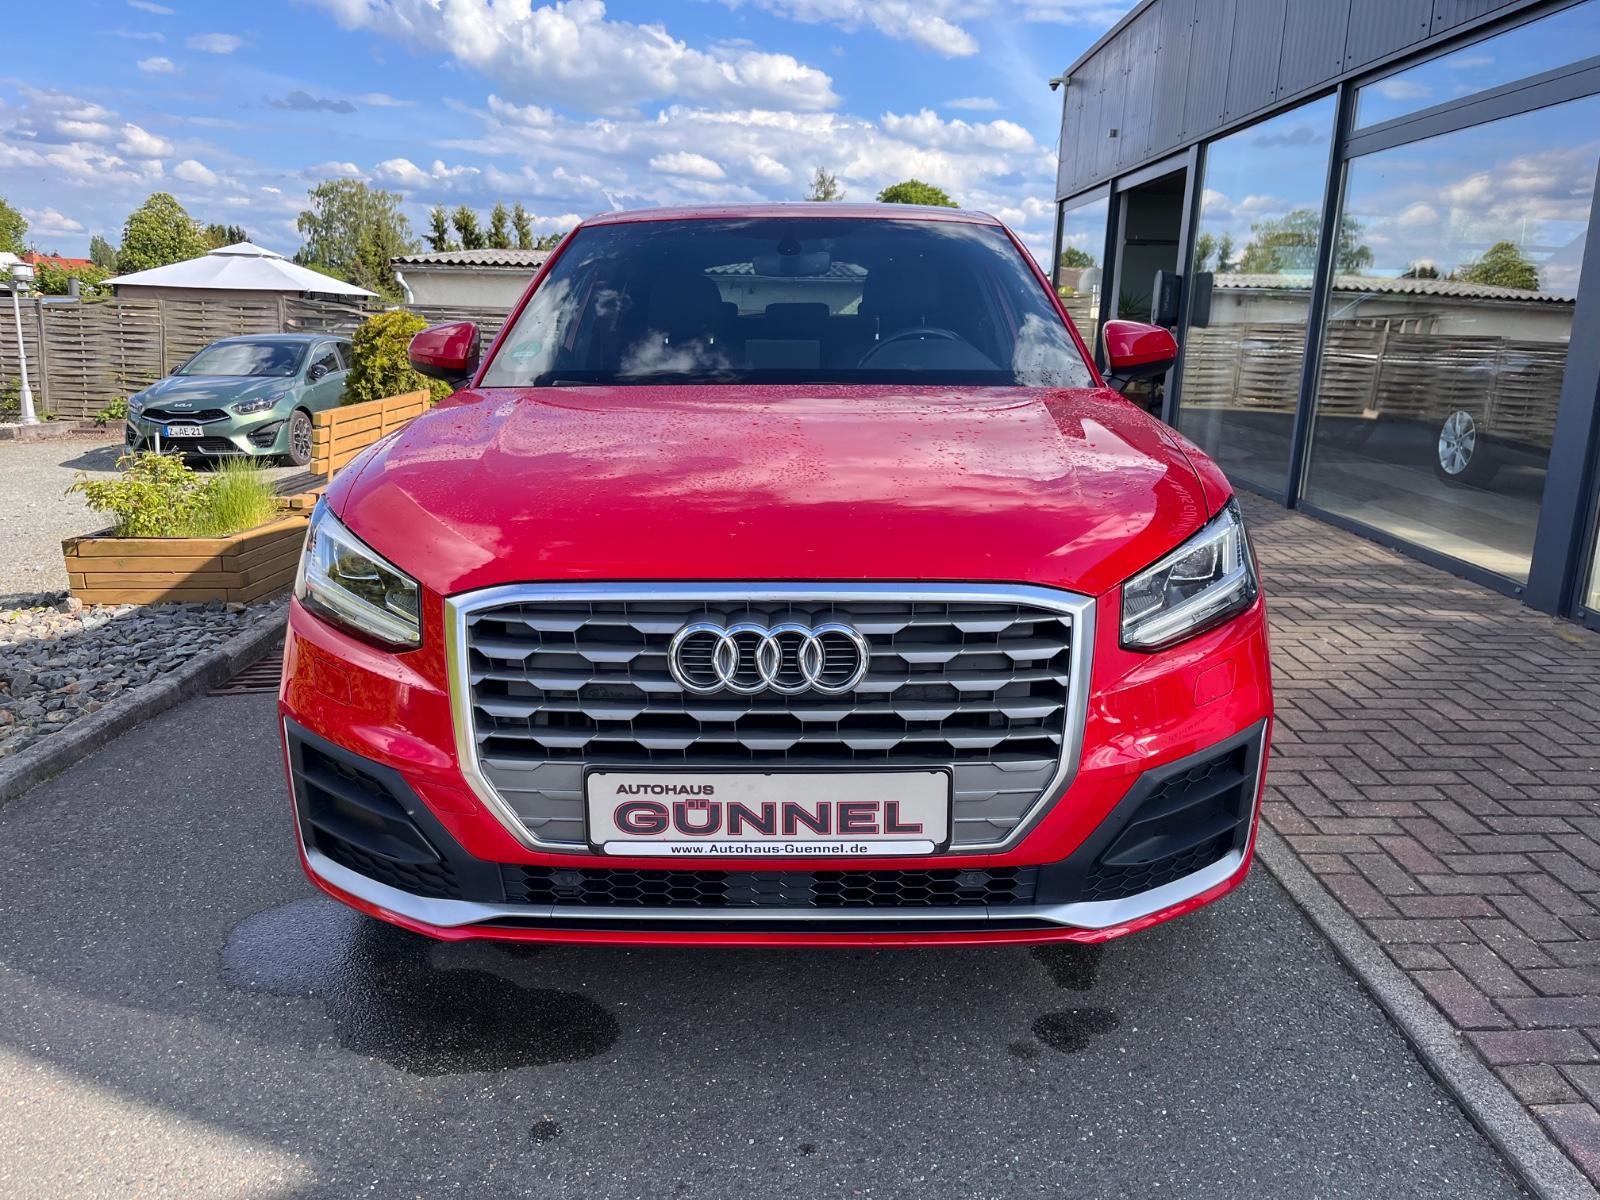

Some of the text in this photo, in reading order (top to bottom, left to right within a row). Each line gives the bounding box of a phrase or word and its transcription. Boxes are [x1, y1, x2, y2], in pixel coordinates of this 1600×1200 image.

[179, 427, 190, 435] AE
[191, 427, 202, 435] 21
[616, 784, 714, 795] AUTOHAUS
[613, 799, 923, 836] GÜNNEL
[670, 843, 868, 854] www.Autohaus-Guennel.de
